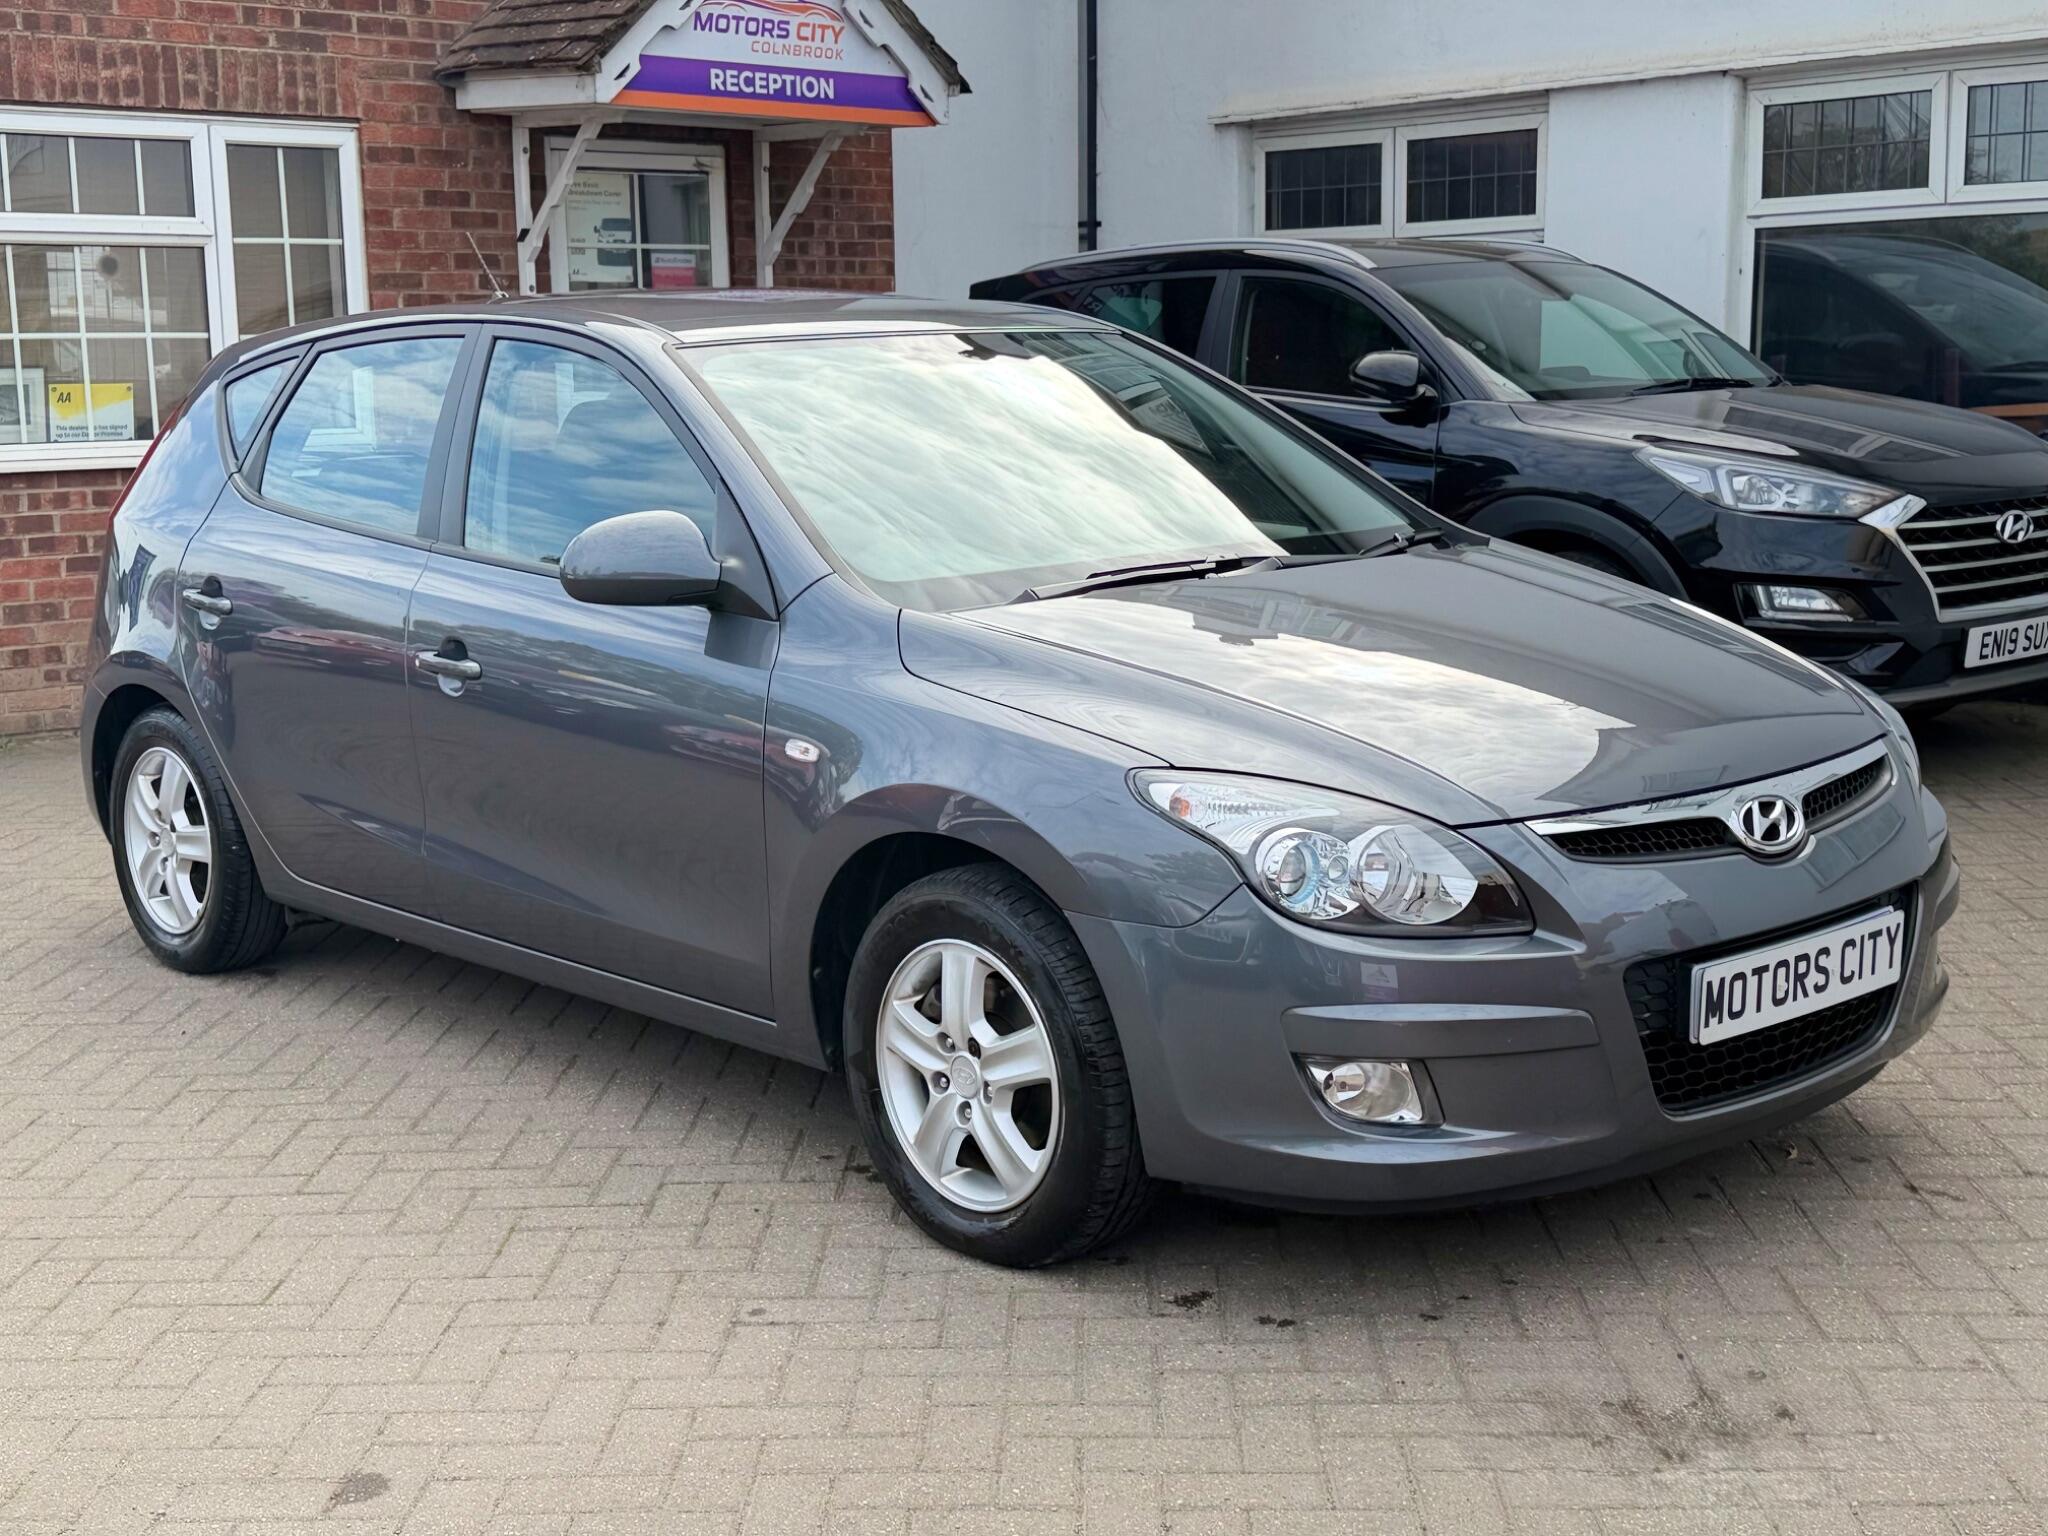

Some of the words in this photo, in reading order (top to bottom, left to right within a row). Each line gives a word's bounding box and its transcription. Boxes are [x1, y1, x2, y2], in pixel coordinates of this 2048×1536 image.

[693, 11, 790, 39] MOTORS
[796, 22, 845, 44] CITY
[751, 40, 844, 60] COLNBROOK
[709, 68, 835, 99] RECEPTION
[56, 391, 71, 403] AA
[68, 424, 97, 432] dealersp
[1979, 627, 2019, 660] EN19
[1704, 946, 1831, 1029] MOTORS
[1840, 922, 1901, 985] CITY
